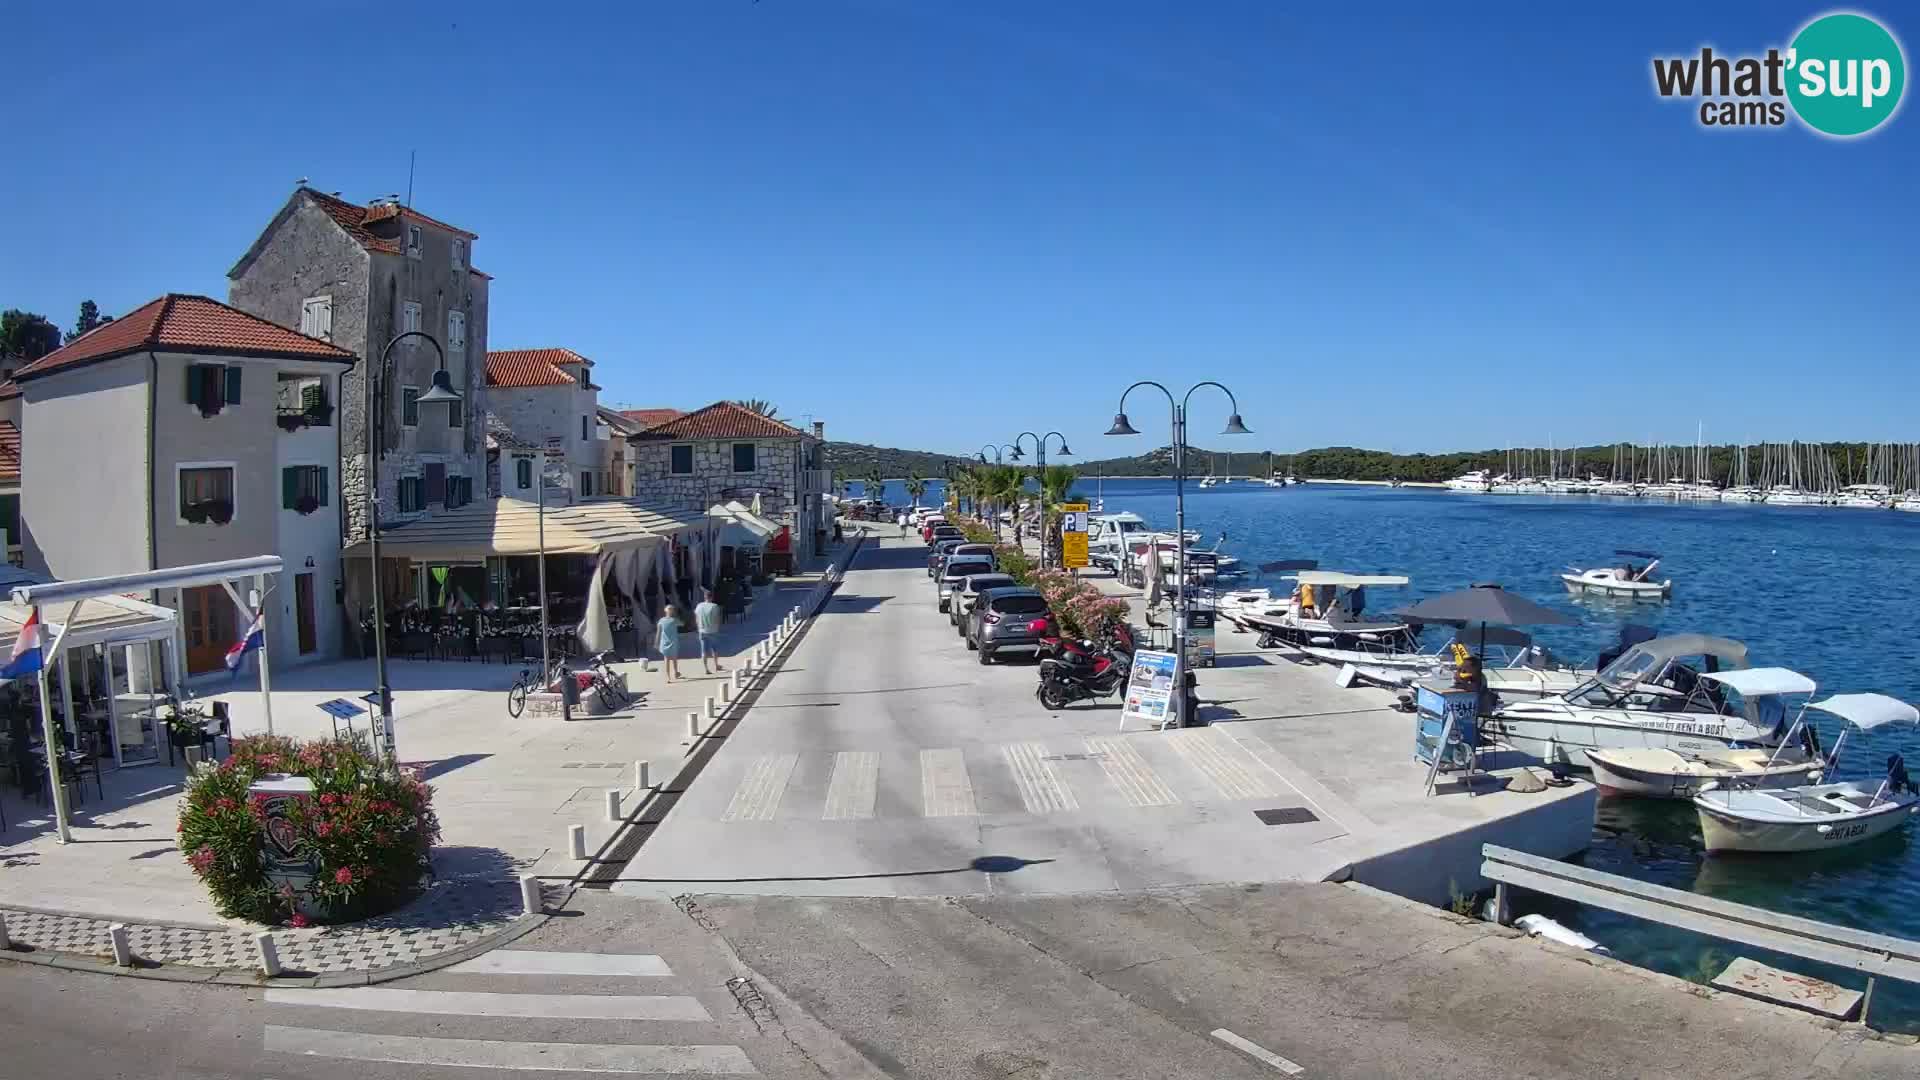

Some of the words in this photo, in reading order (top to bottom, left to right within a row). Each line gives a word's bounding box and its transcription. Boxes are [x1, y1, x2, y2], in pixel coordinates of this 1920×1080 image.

[1065, 514, 1075, 530] P
[1675, 722, 1696, 733] RENT
[1697, 724, 1703, 733] A
[1705, 724, 1725, 736] BOAT
